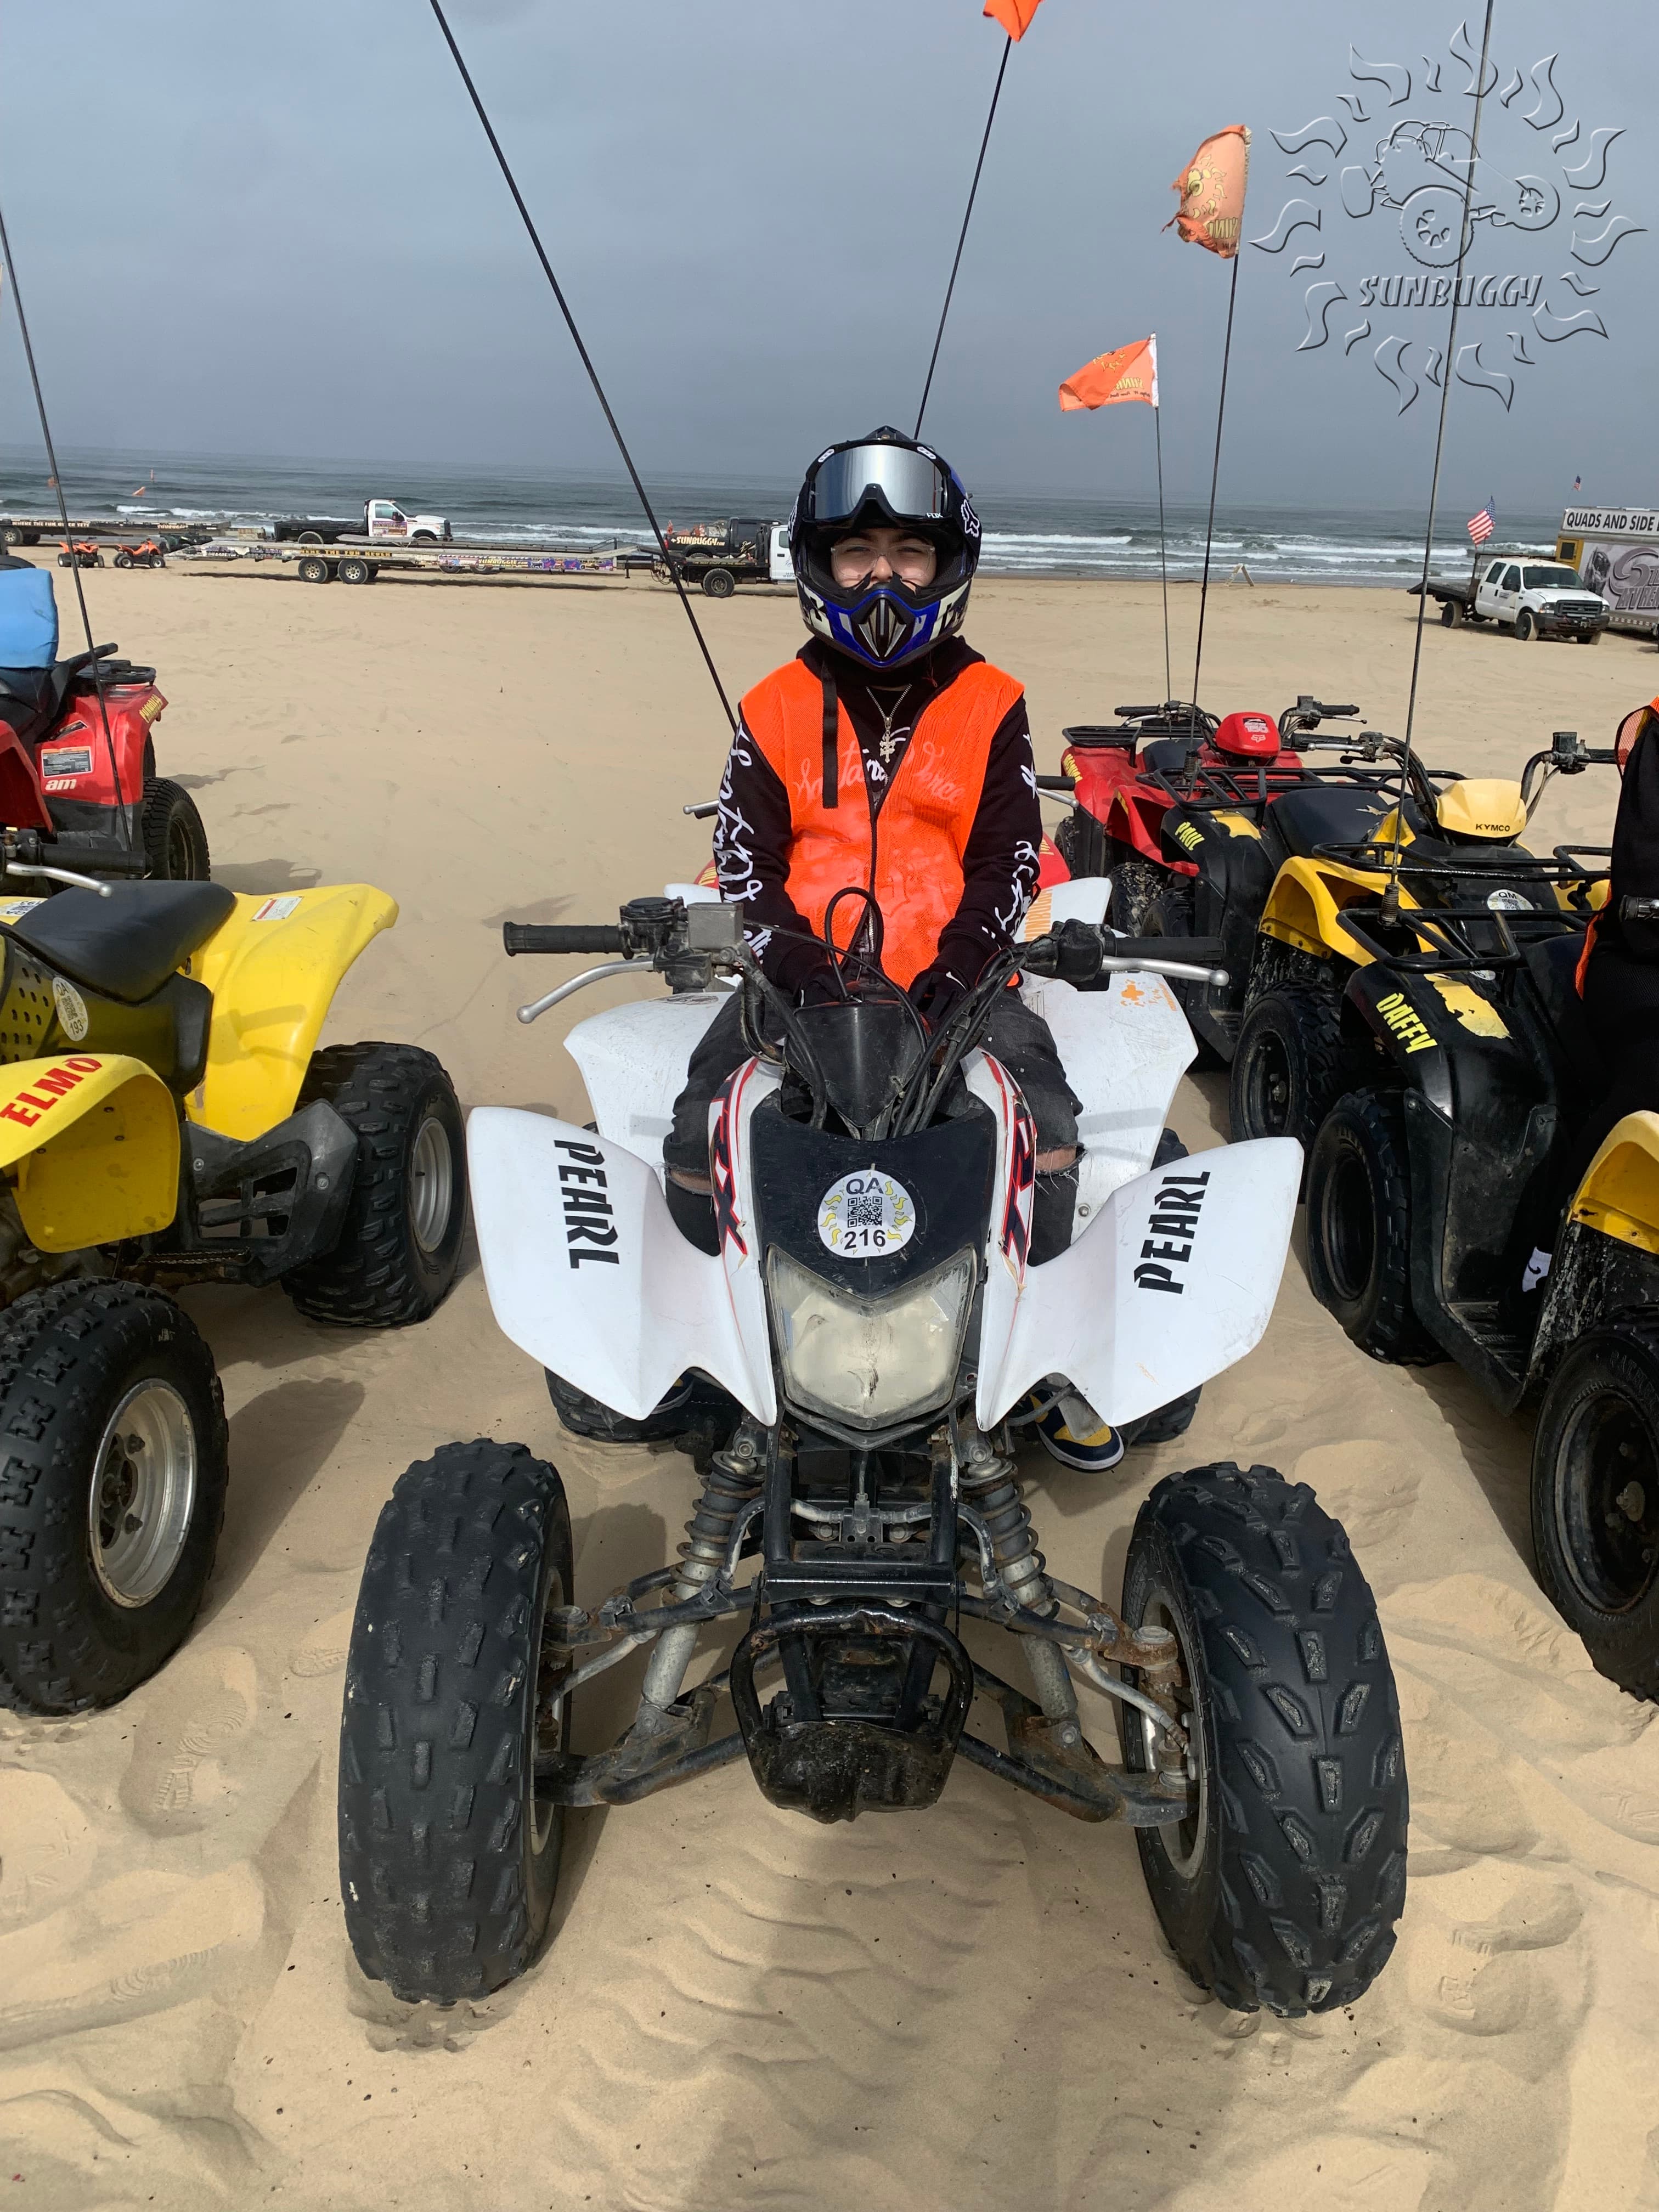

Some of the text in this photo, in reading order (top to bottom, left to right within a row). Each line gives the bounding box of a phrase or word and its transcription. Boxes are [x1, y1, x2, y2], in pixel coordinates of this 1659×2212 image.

[1567, 512, 1655, 531] QUADS AND SIDE
[45, 779, 77, 790] am
[1175, 821, 1205, 851] PAUL
[56, 982, 69, 996] QA
[70, 1020, 83, 1035] 193
[1376, 992, 1438, 1053] DAFFY
[0, 1057, 103, 1127] ELMO
[846, 1177, 884, 1194] QA
[554, 1140, 619, 1268] PEARL
[844, 1228, 885, 1248] 216
[1134, 1171, 1211, 1294] PEARL
